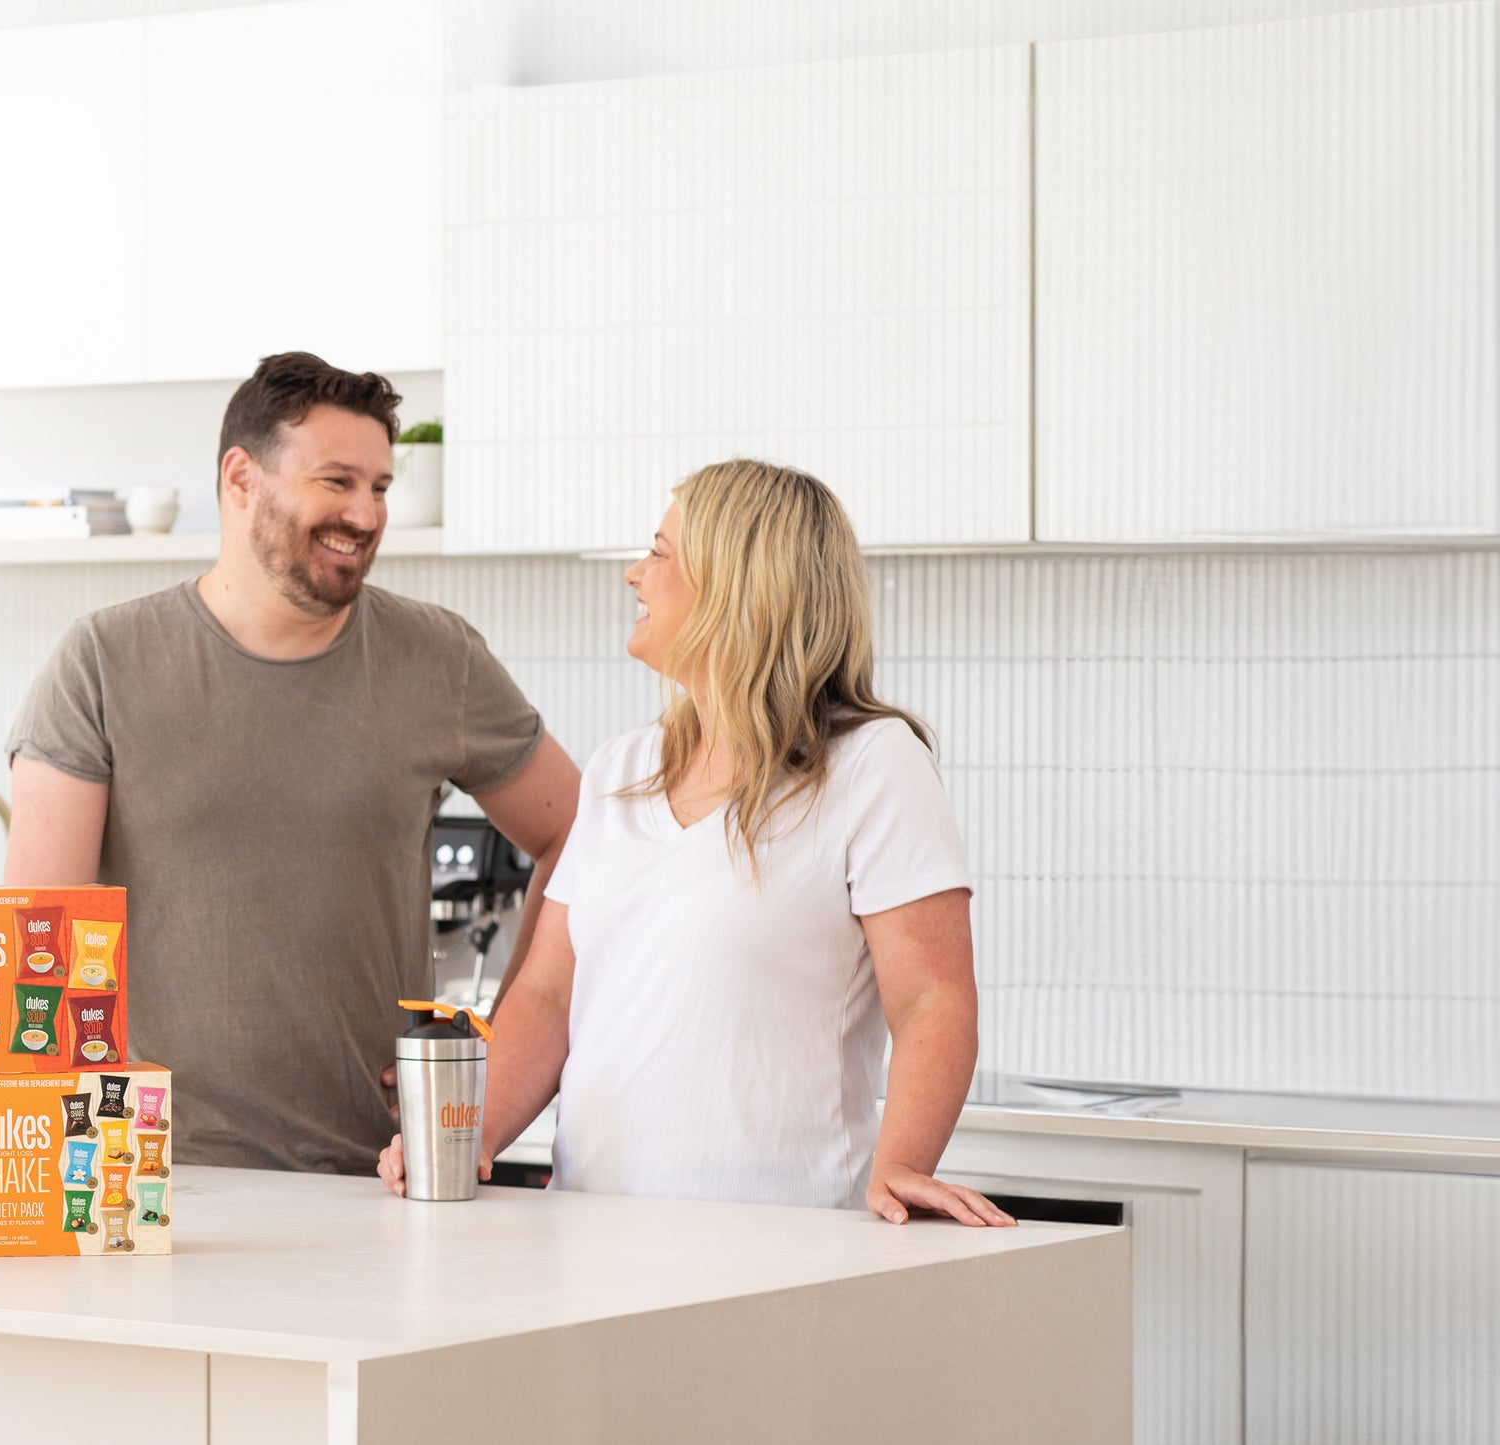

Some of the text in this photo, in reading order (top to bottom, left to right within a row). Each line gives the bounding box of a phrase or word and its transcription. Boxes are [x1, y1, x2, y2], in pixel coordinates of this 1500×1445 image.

[28, 920, 51, 933] dukes
[30, 934, 49, 946] SOUP
[85, 932, 107, 946] dukes
[86, 947, 105, 959] SOUP
[26, 996, 49, 1010] dukes
[26, 1011, 46, 1023] SOUP
[81, 1008, 104, 1022] dukes
[83, 1023, 103, 1035] SOUP
[441, 1101, 480, 1128] dukes
[20, 1202, 44, 1217] PACK
